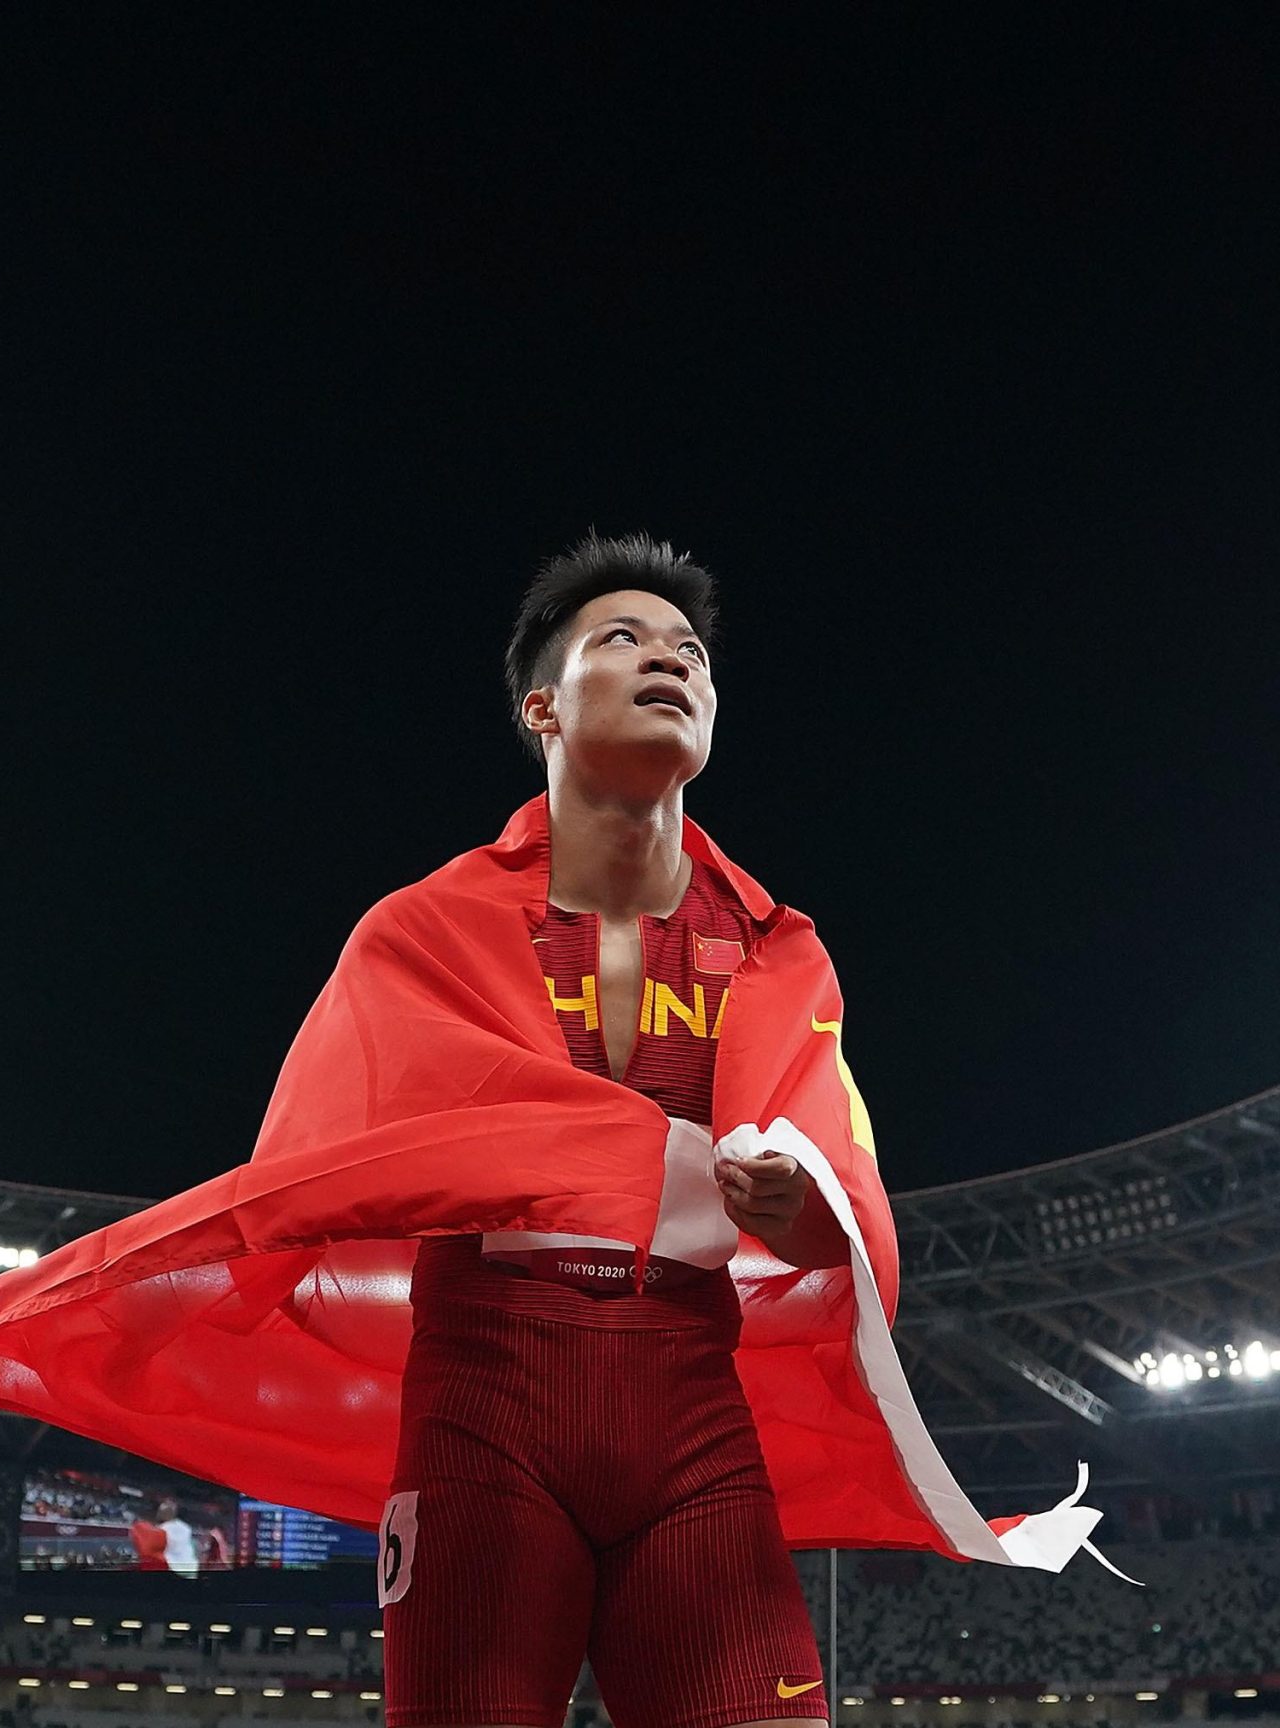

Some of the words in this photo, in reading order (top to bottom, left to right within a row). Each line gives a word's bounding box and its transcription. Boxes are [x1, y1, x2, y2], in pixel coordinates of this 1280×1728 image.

[543, 975, 729, 1039] HIN
[557, 1261, 595, 1276] TOKYO
[597, 1265, 625, 1278] 2020
[384, 1503, 402, 1593] 6
